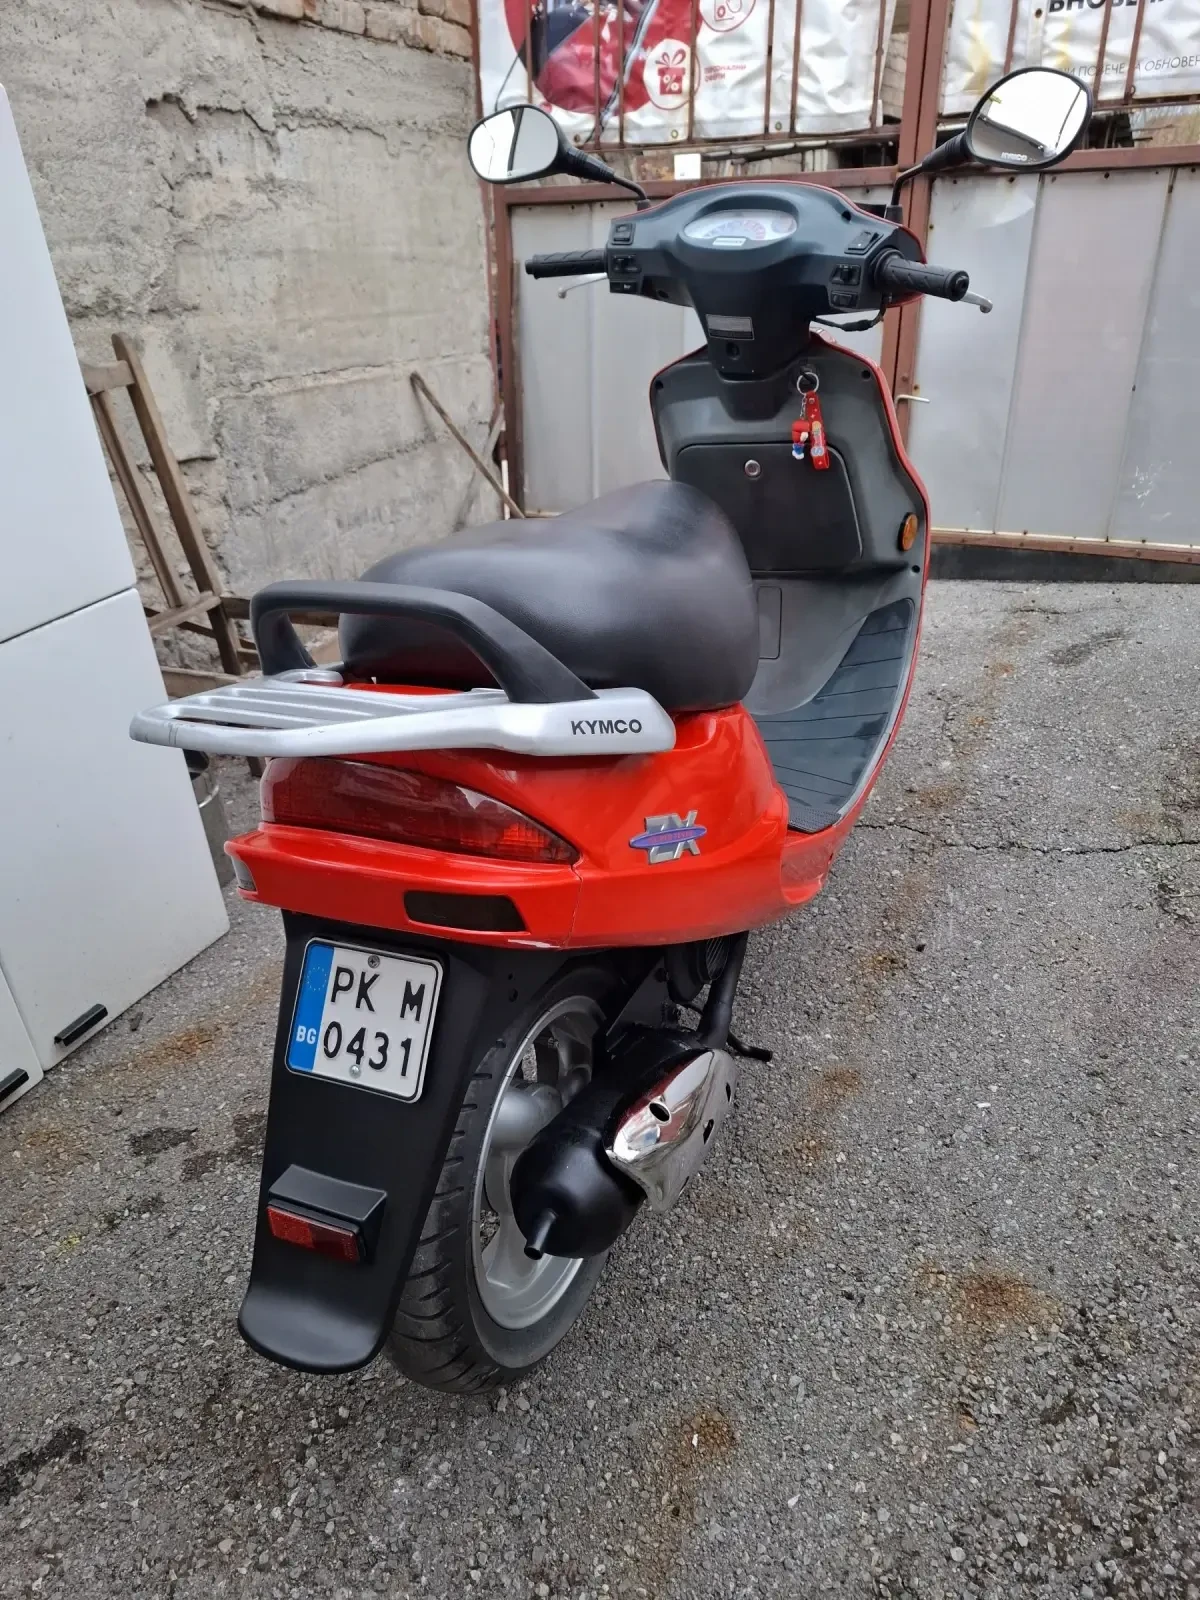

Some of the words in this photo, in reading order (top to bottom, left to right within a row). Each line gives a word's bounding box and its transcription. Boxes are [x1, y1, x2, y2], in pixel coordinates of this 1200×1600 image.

[1078, 62, 1126, 76] ПОЕЧЕ
[571, 719, 642, 735] KYMCO
[330, 966, 380, 1013] PK
[400, 980, 426, 1022] M
[295, 1025, 317, 1044] BG
[323, 1021, 412, 1077] 0431
